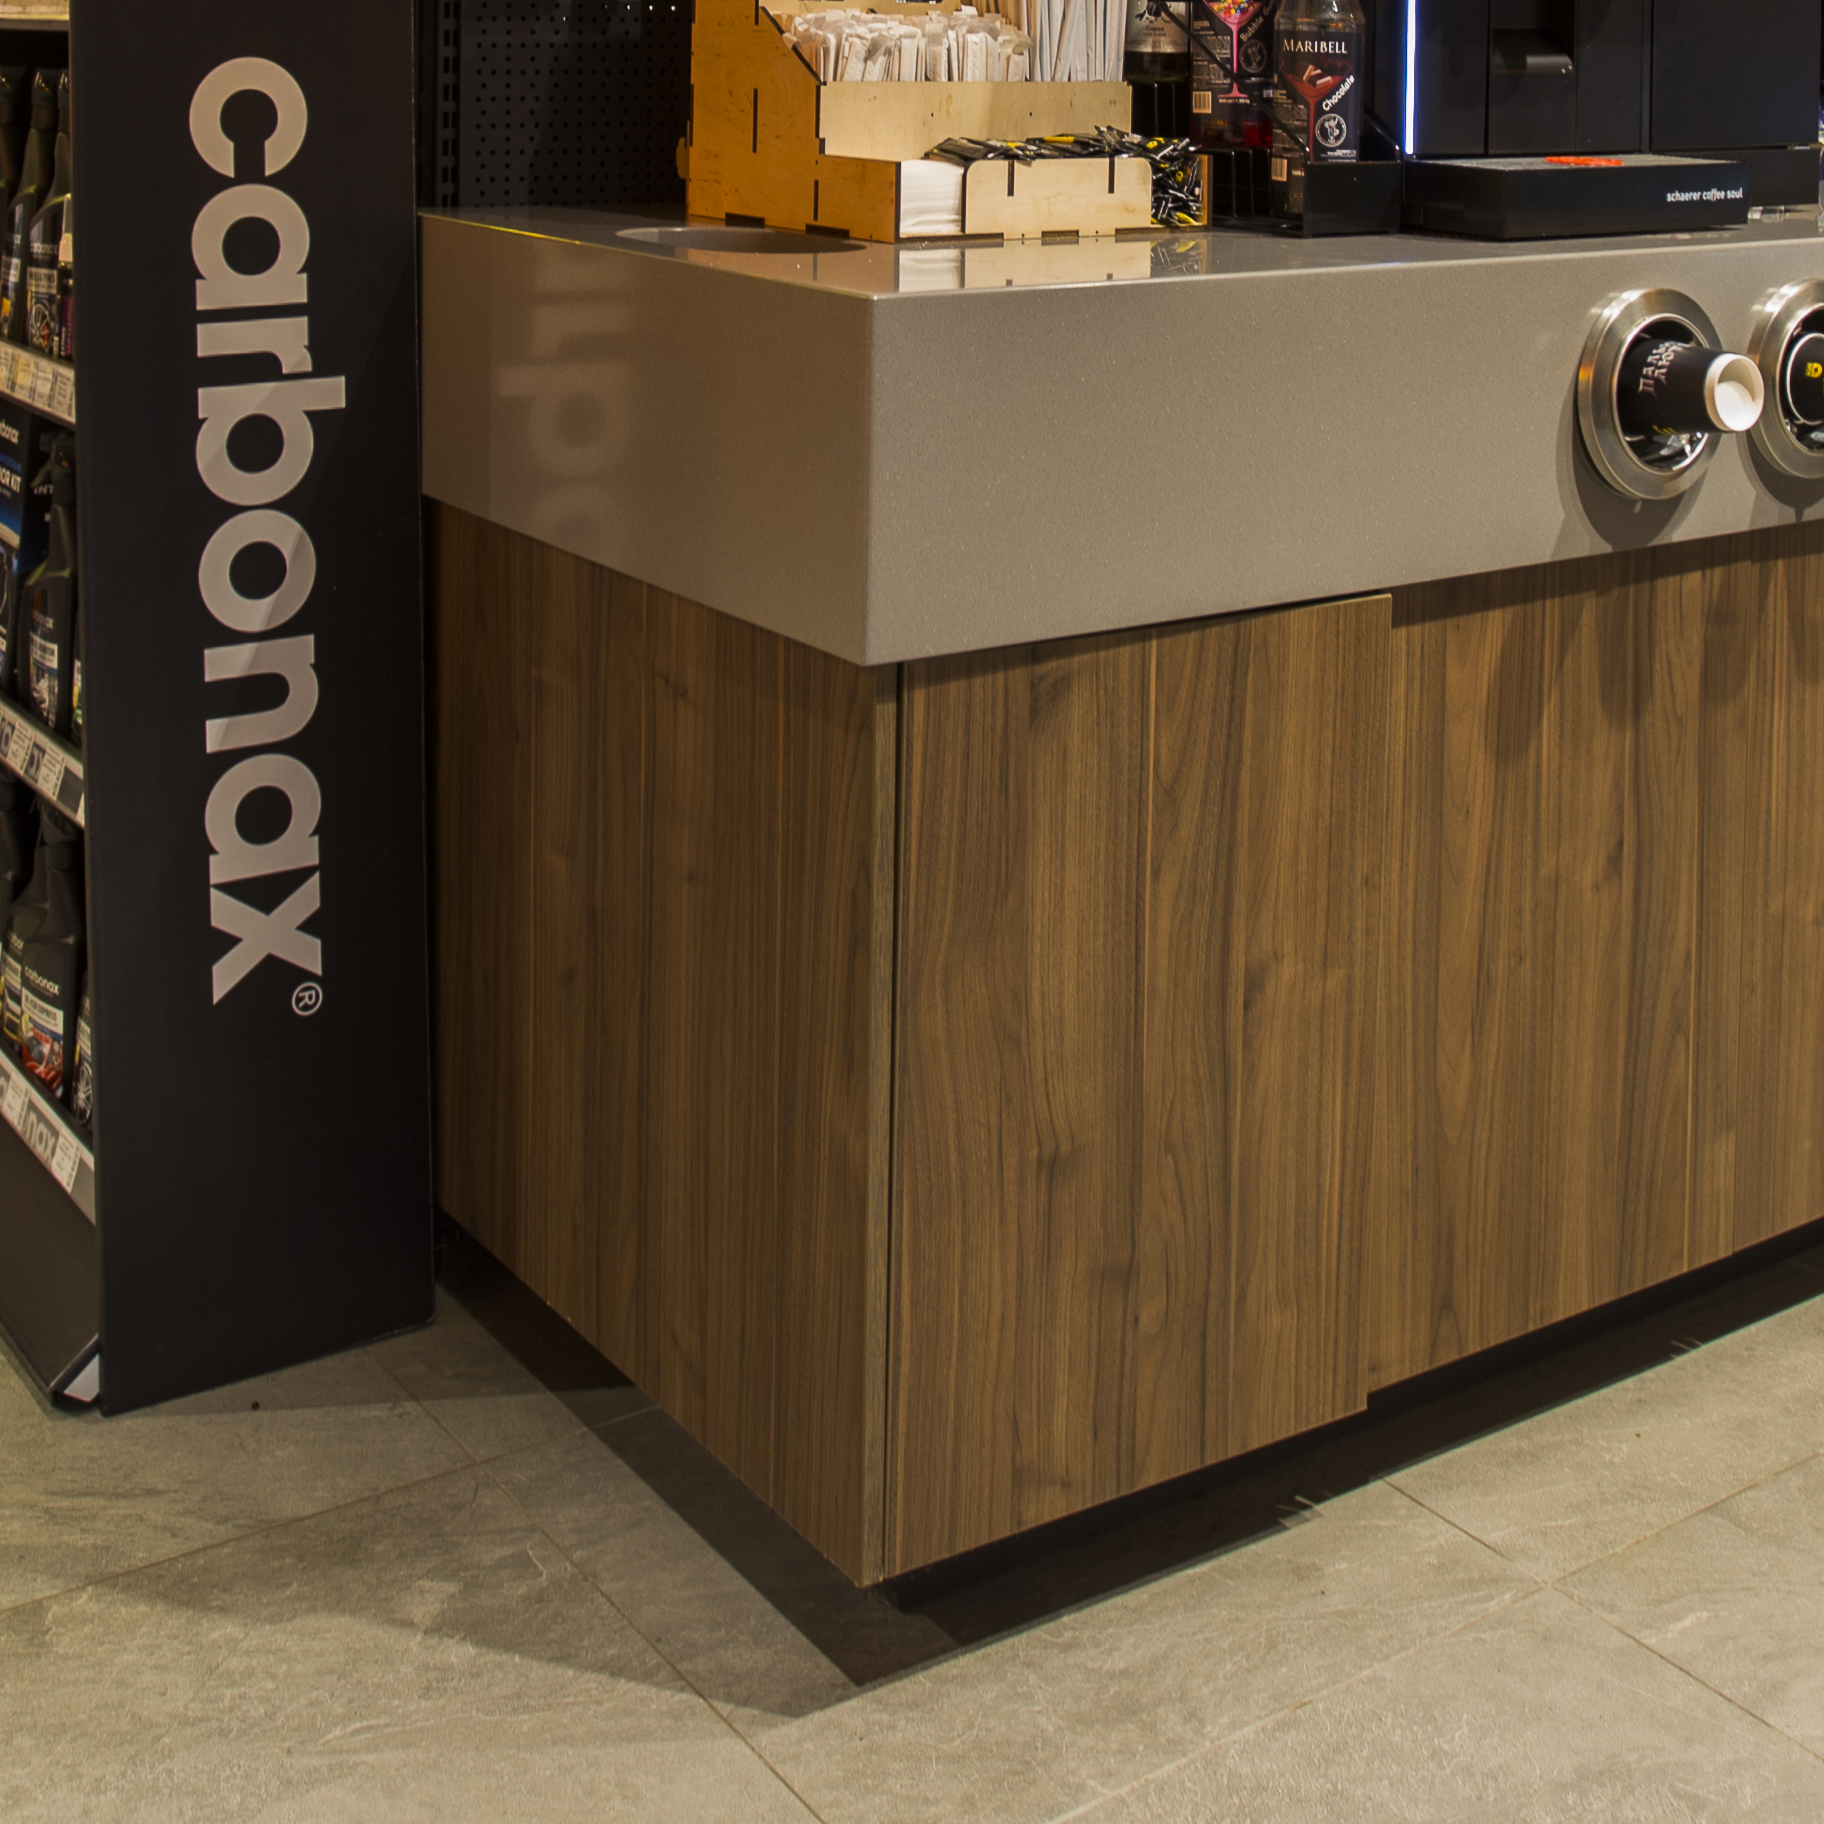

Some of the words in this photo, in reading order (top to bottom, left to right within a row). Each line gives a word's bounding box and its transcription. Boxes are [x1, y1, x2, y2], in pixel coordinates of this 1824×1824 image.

[1239, 14, 1265, 43] Bubble
[1282, 38, 1348, 55] MARIBELL
[1321, 73, 1356, 112] Chocolate
[1666, 189, 1702, 203] schaerer
[1702, 187, 1726, 202] coffee
[1727, 186, 1744, 199] soul
[10, 472, 23, 494] KIT
